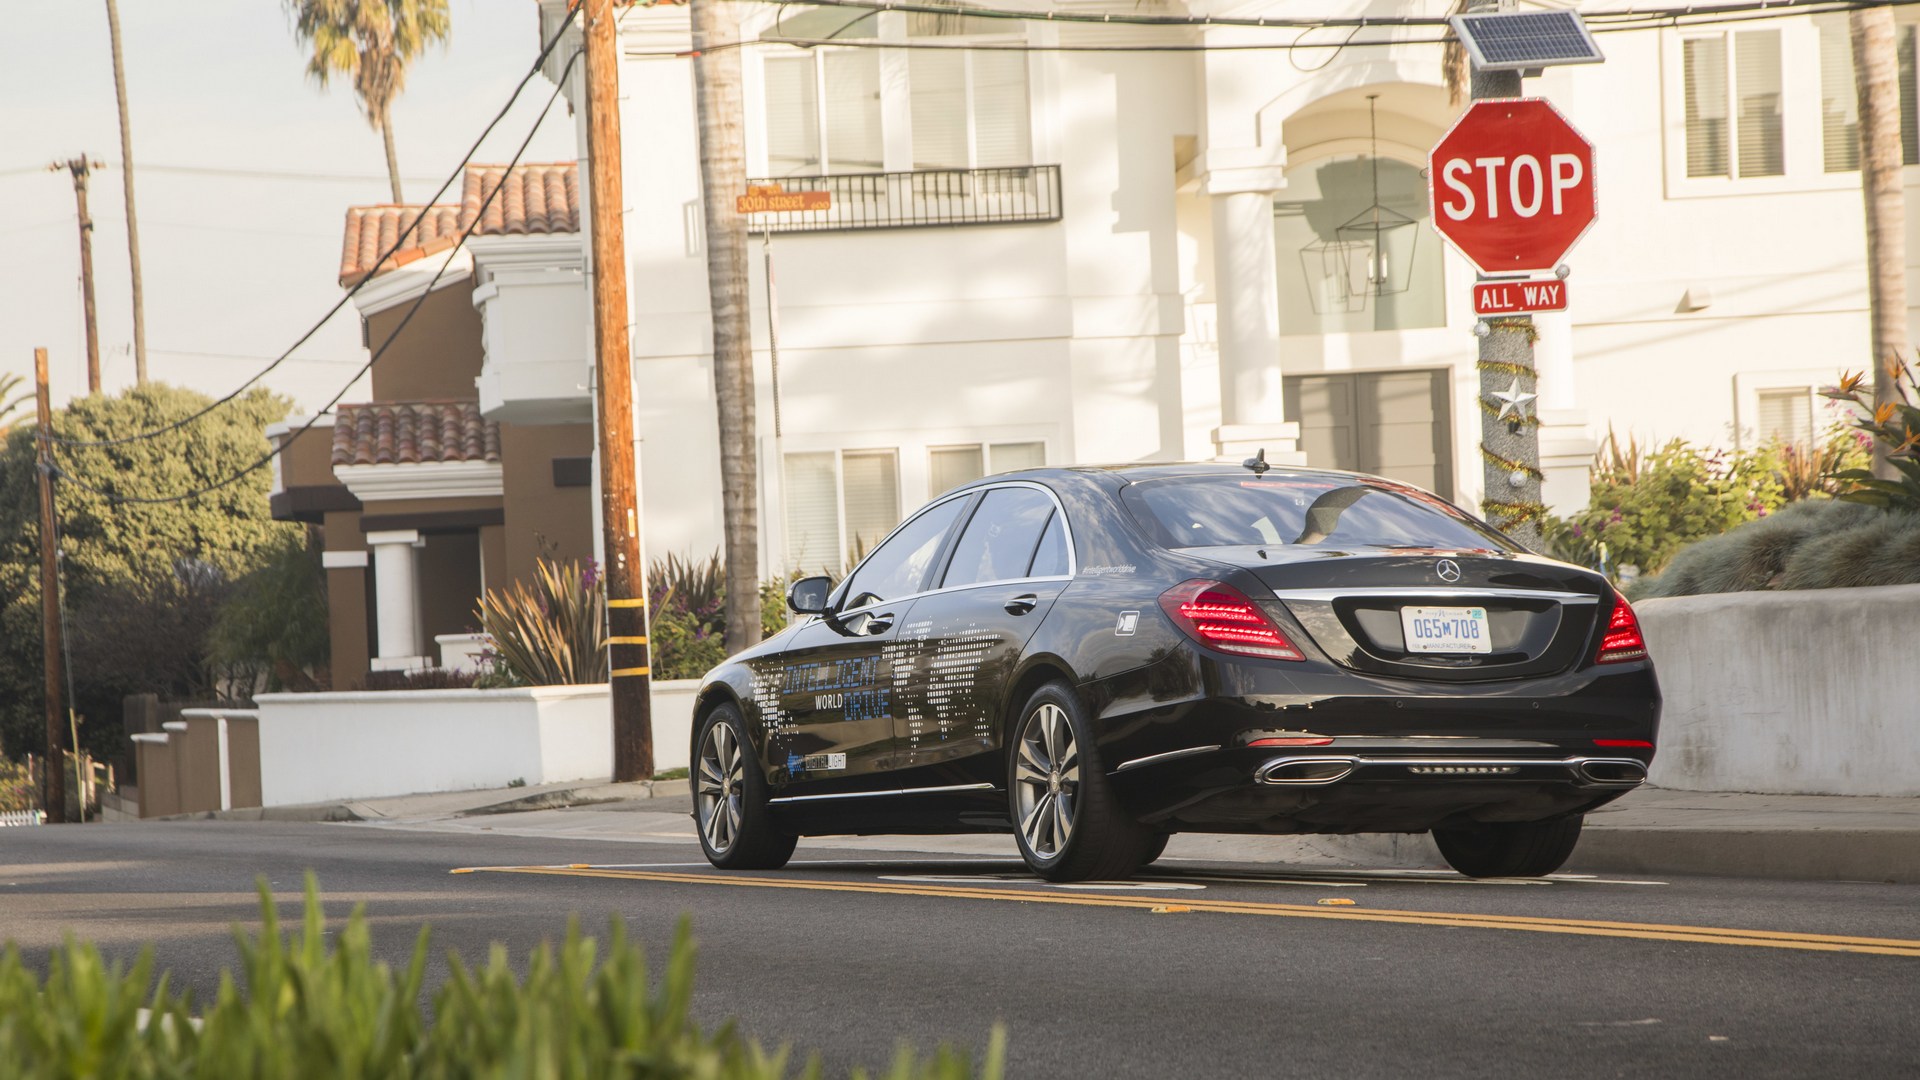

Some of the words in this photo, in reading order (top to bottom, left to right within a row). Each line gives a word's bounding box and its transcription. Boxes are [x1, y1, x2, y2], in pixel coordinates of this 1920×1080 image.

[1442, 153, 1583, 221] STOP
[1480, 288, 1514, 309] ALL
[1523, 285, 1560, 306] WAY
[1414, 618, 1480, 639] 065M708
[815, 693, 843, 710] WORLD
[844, 688, 891, 721] DRIVE
[829, 754, 845, 768] LIGHT
